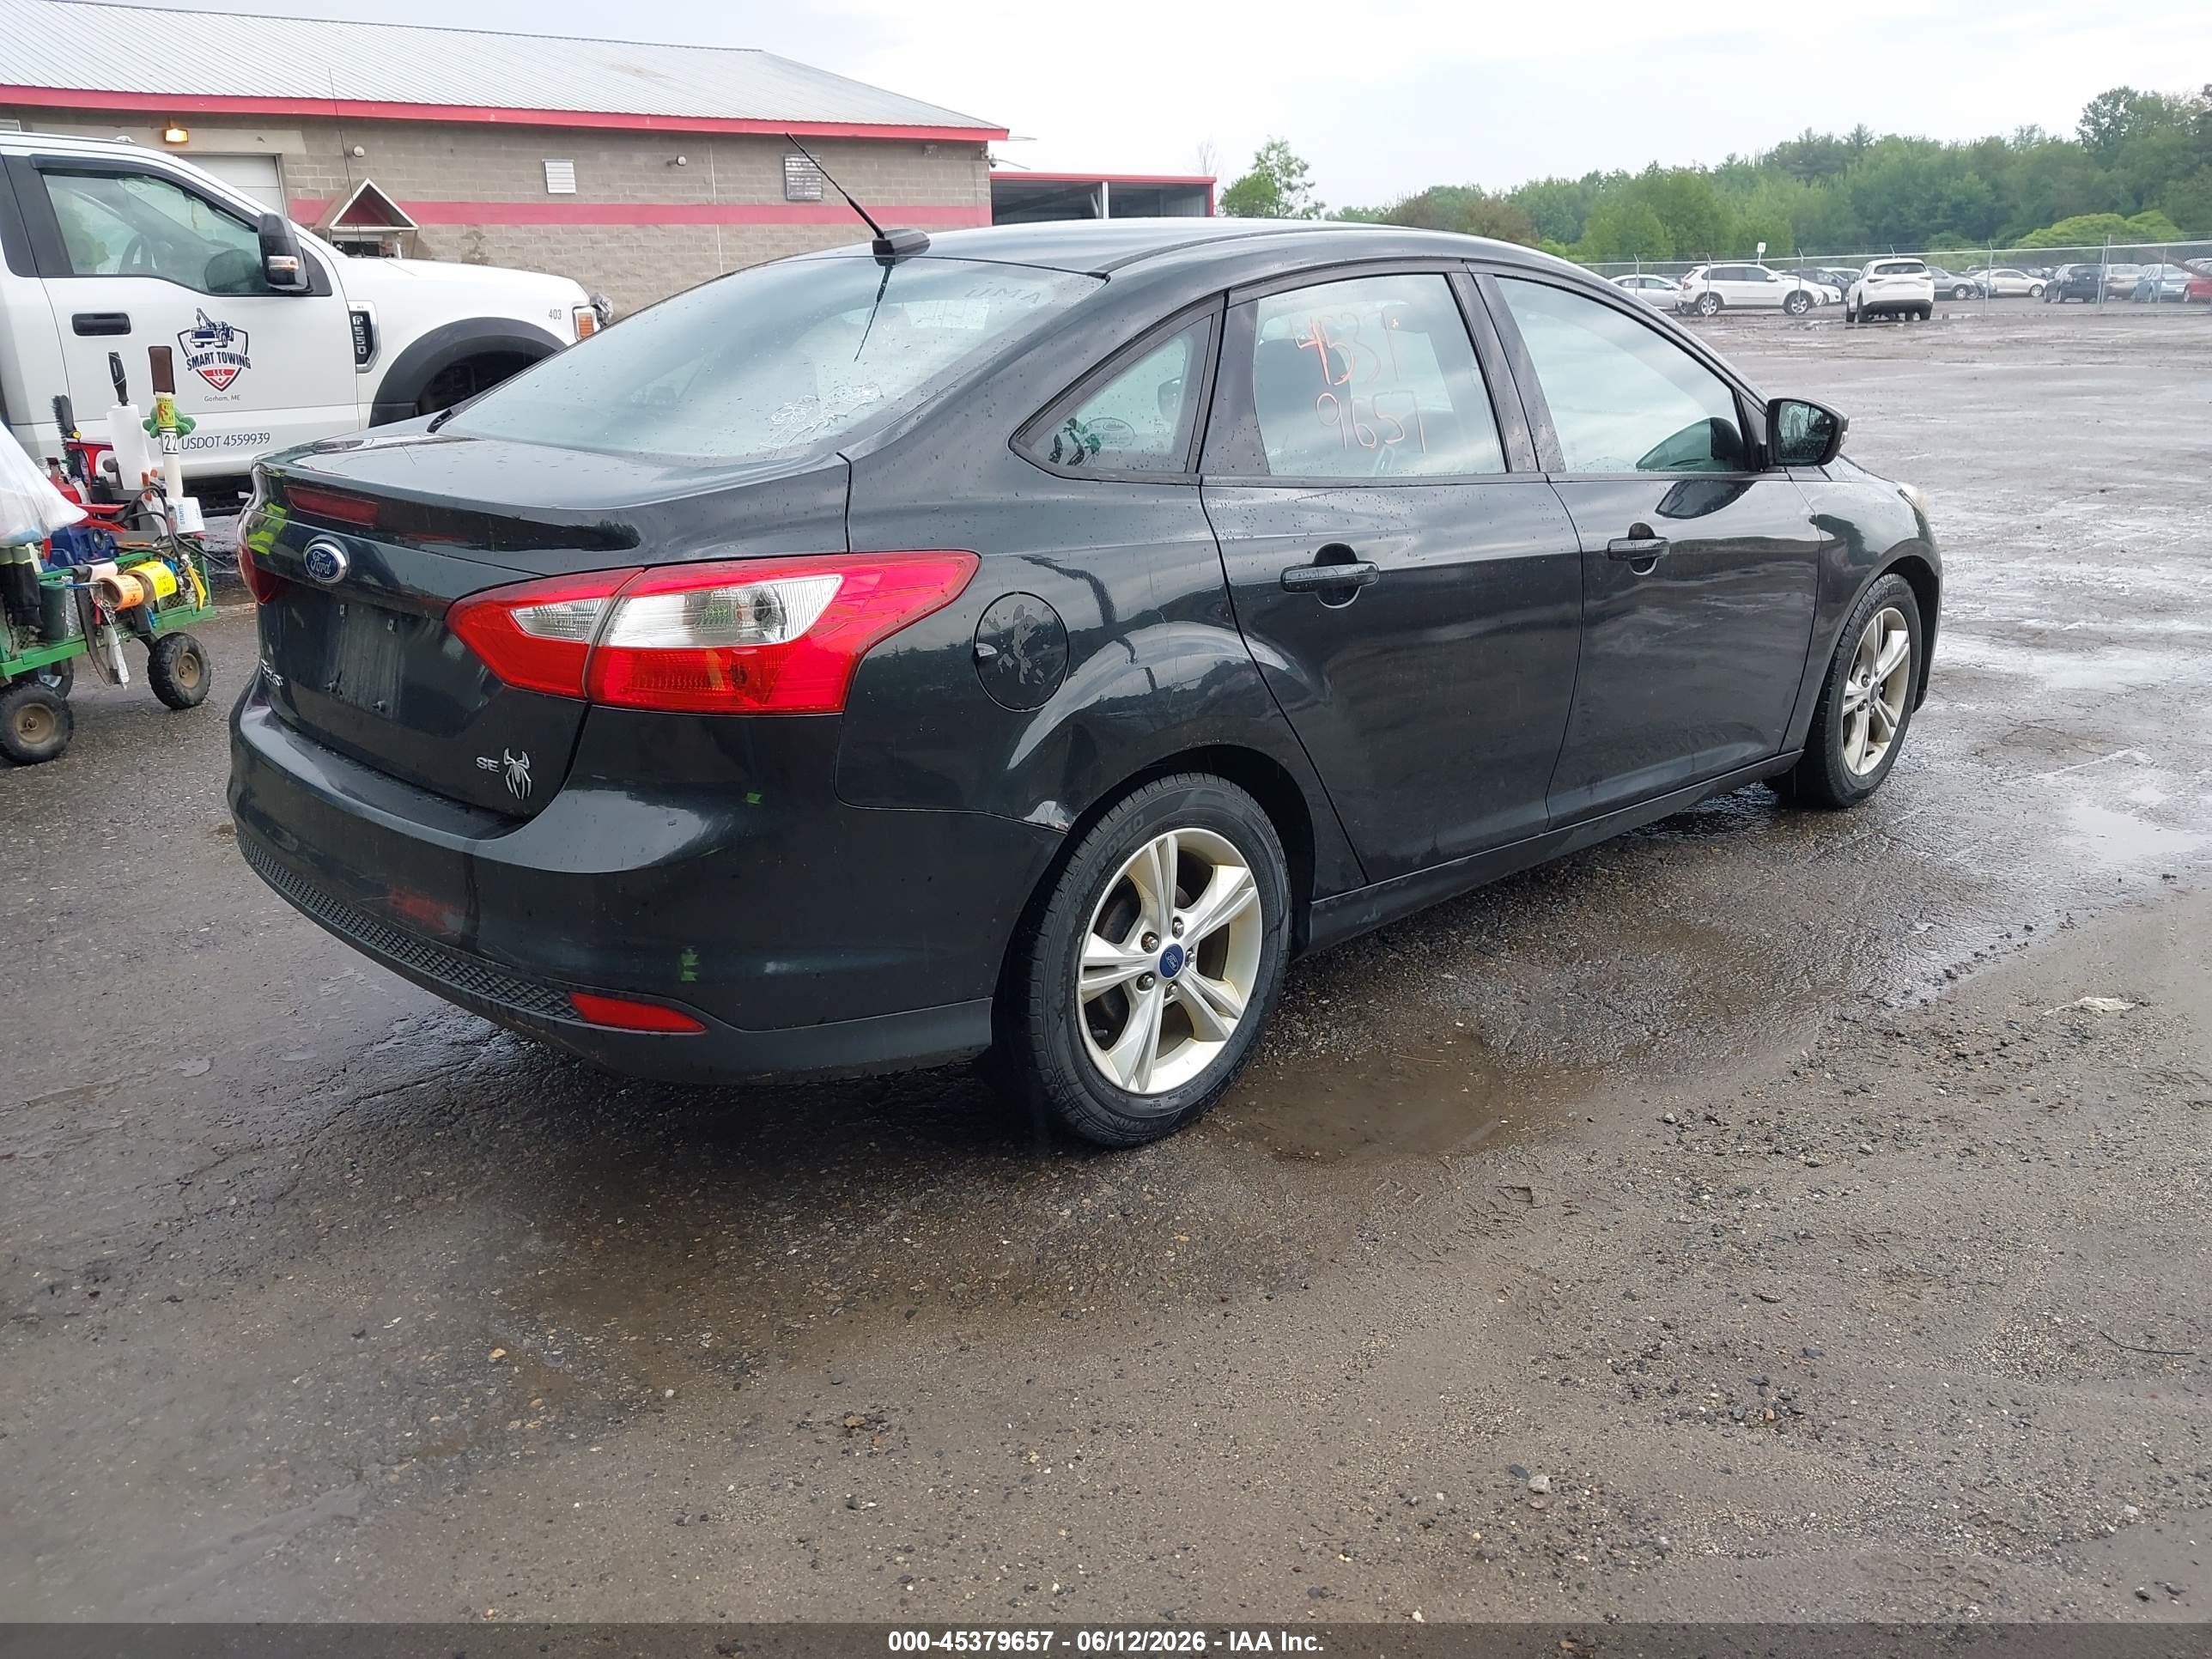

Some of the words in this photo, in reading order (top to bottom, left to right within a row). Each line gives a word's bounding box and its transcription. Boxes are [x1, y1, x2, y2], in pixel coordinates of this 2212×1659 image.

[548, 308, 562, 320] 403
[186, 351, 214, 371] SMART
[216, 351, 252, 369] TOWING
[1315, 391, 1426, 454] 9657
[181, 435, 222, 450] USDOT
[222, 432, 270, 447] 4559939
[310, 550, 332, 575] Ford
[476, 757, 500, 773] SE
